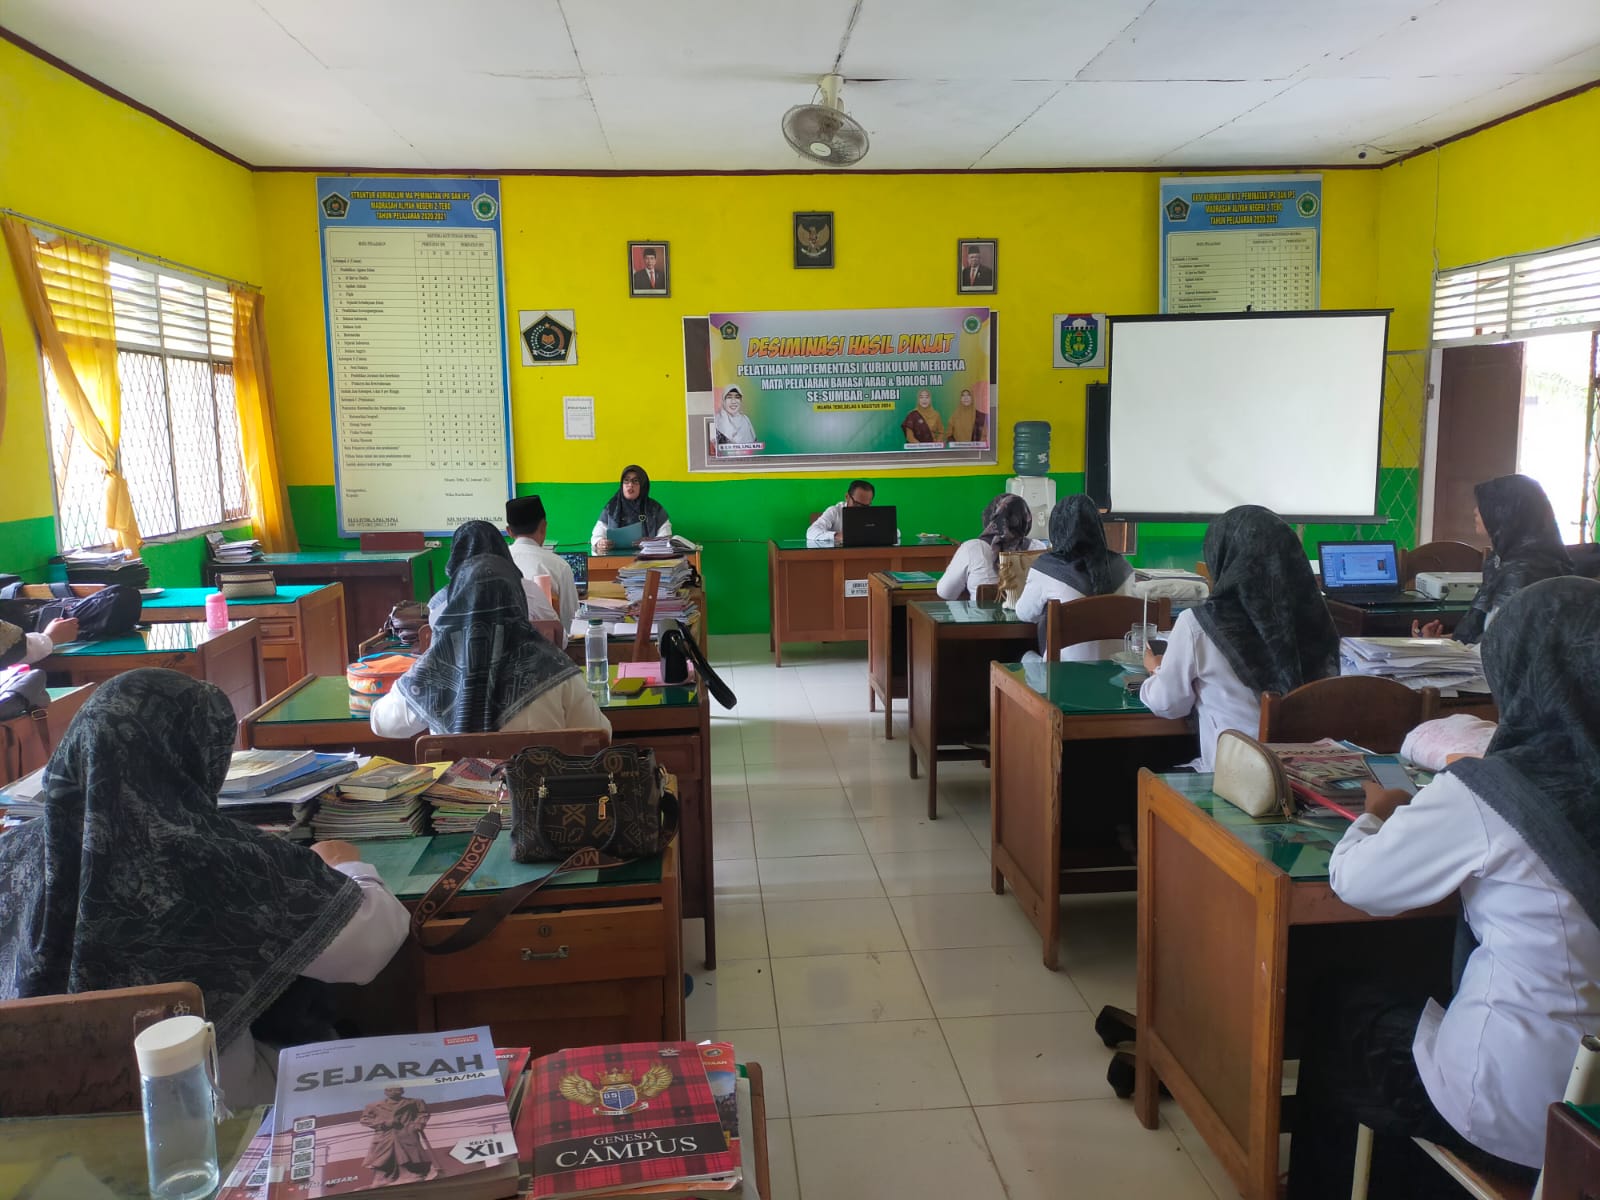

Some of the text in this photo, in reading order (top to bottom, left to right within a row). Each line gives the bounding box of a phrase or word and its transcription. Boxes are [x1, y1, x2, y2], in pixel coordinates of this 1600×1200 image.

[747, 332, 956, 358] DESIMINASI HASIL DIKLAT
[737, 359, 966, 376] PELATIHAN IMPLEMENTASI KURIKULUM MERDEKA
[761, 374, 943, 390] MATA PELAJARAN BAHASA ARAB & BIOLOGI MA
[807, 390, 863, 402] SE-SUMBAR
[871, 389, 900, 401] JAMBI
[293, 1053, 484, 1092] SEJARAH
[434, 1071, 486, 1084] SMA/MA
[469, 1138, 494, 1146] KELAS
[593, 1130, 658, 1146] GENESIA
[463, 1141, 505, 1160] XII
[554, 1136, 698, 1168] CAMPUS
[325, 1175, 359, 1186] AKSARA
